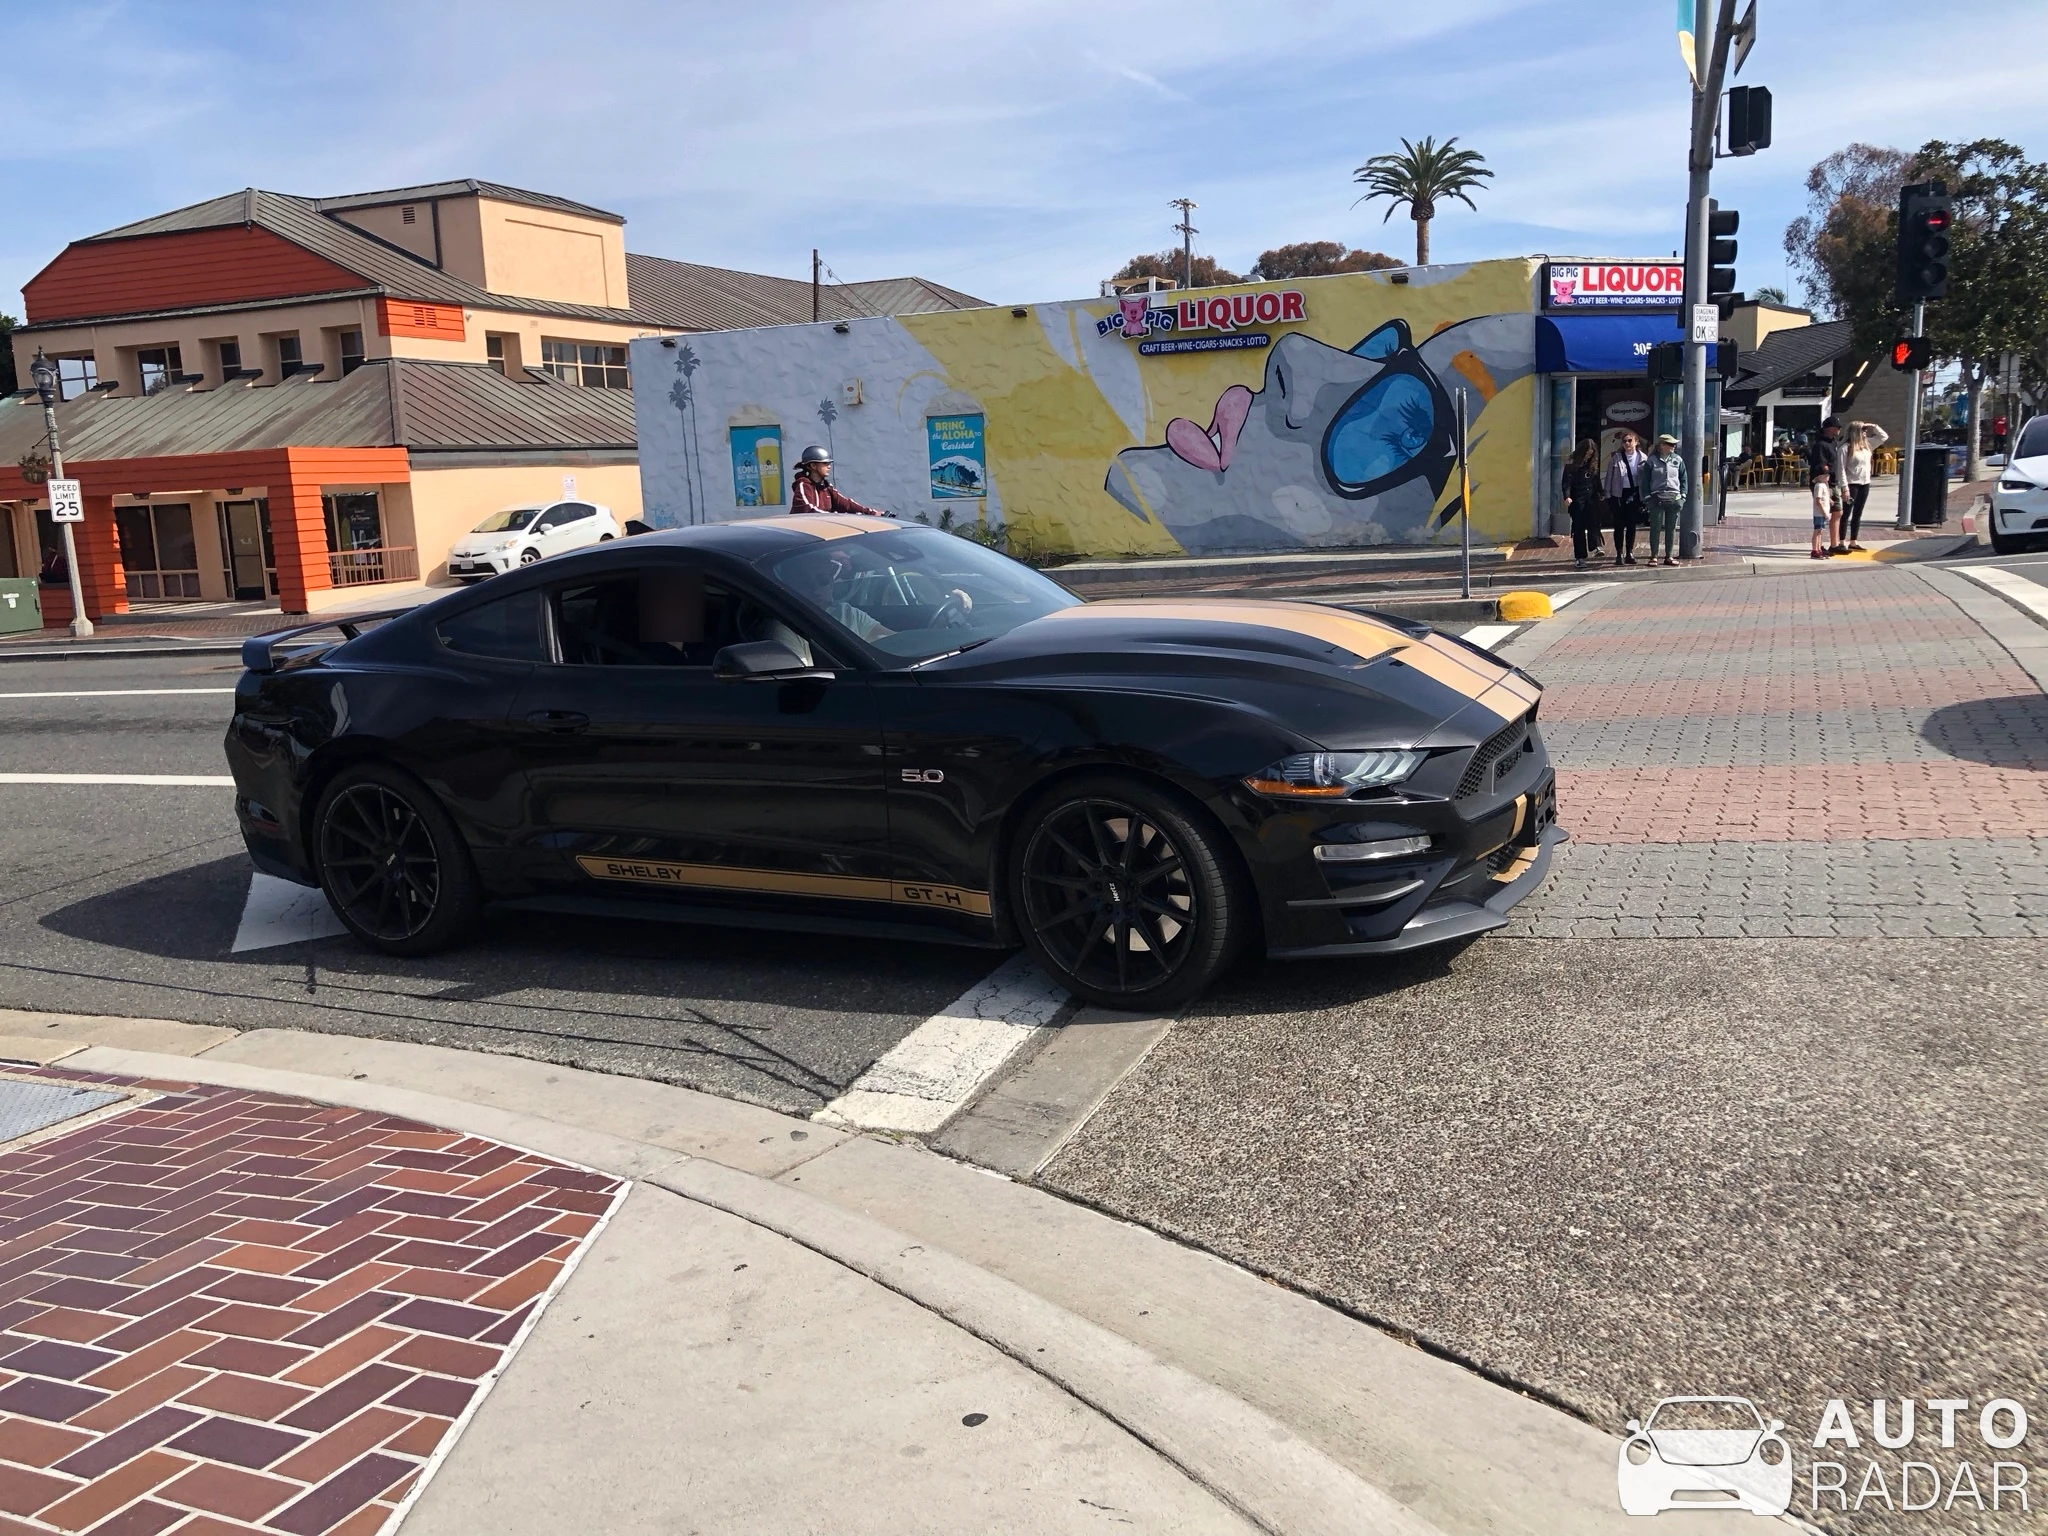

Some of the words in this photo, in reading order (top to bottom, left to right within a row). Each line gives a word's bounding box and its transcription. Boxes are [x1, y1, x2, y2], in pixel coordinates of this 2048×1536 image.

[1552, 267, 1564, 278] BIG
[1566, 267, 1578, 278] PIG
[1583, 266, 1683, 293] LIQUOR
[1096, 313, 1124, 336] BIG
[1145, 311, 1172, 330] PIG
[1179, 292, 1304, 330] LIQUOR
[1695, 326, 1707, 339] OK
[1141, 343, 1160, 353] CRAFT
[1246, 336, 1267, 346] LOTTO
[935, 420, 965, 431] BRING
[932, 432, 941, 440] the
[942, 429, 975, 440] ALOHA
[941, 441, 975, 450] Carlsbad
[55, 492, 75, 500] LIMIT
[55, 501, 79, 516] 25
[901, 768, 945, 783] 5.0
[607, 863, 683, 881] SHELBY
[904, 887, 961, 906] GT-H
